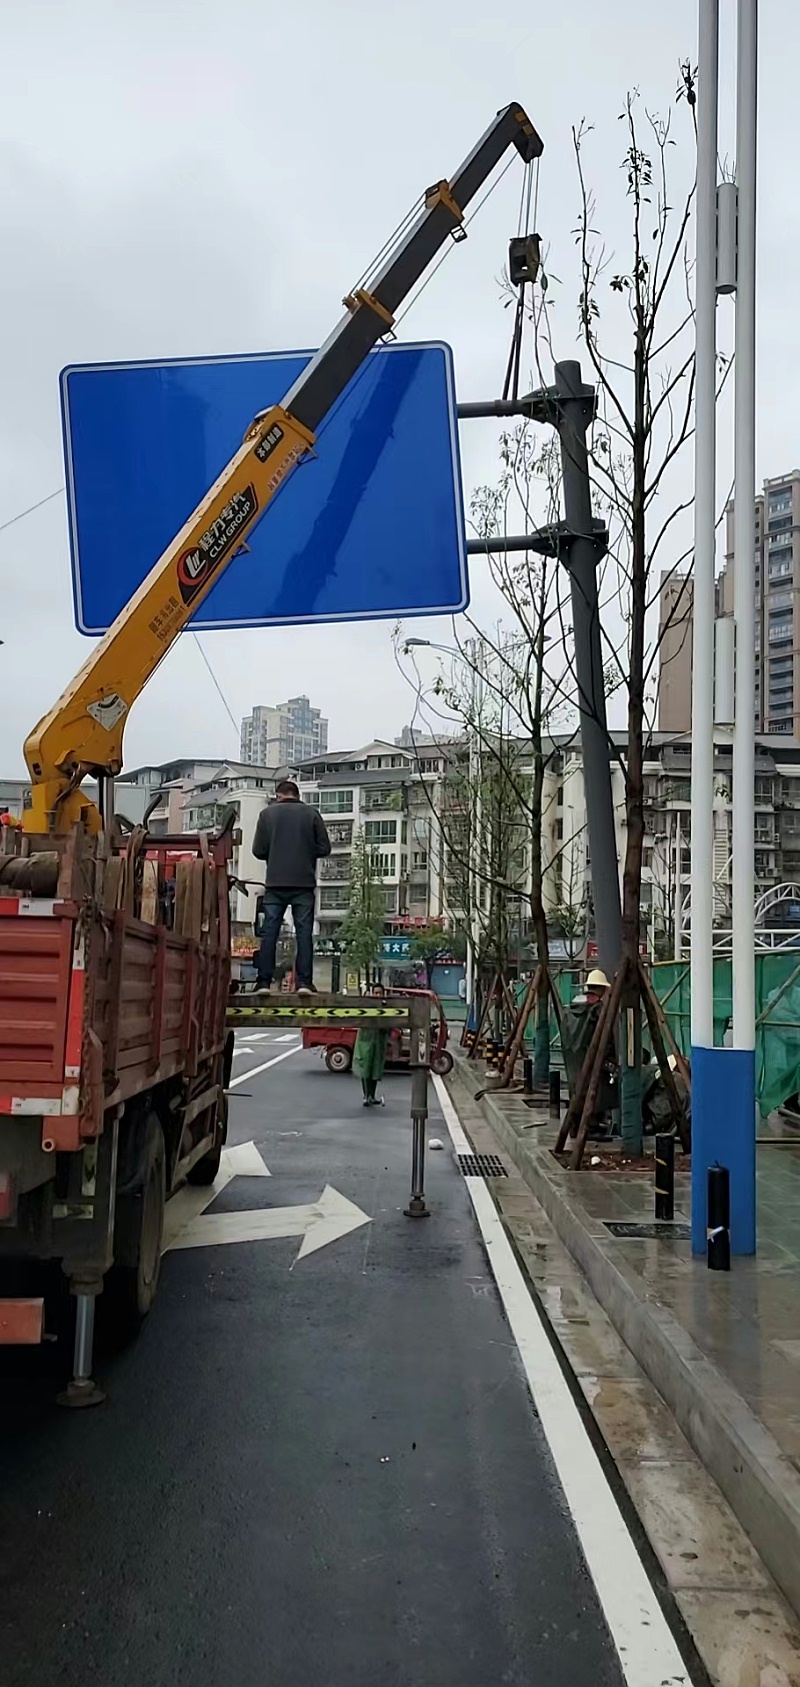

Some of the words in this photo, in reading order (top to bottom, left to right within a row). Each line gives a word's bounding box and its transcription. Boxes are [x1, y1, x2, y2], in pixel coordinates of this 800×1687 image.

[198, 491, 246, 551] 程力专汽
[209, 534, 228, 559] CLW
[226, 501, 251, 537] GROUP
